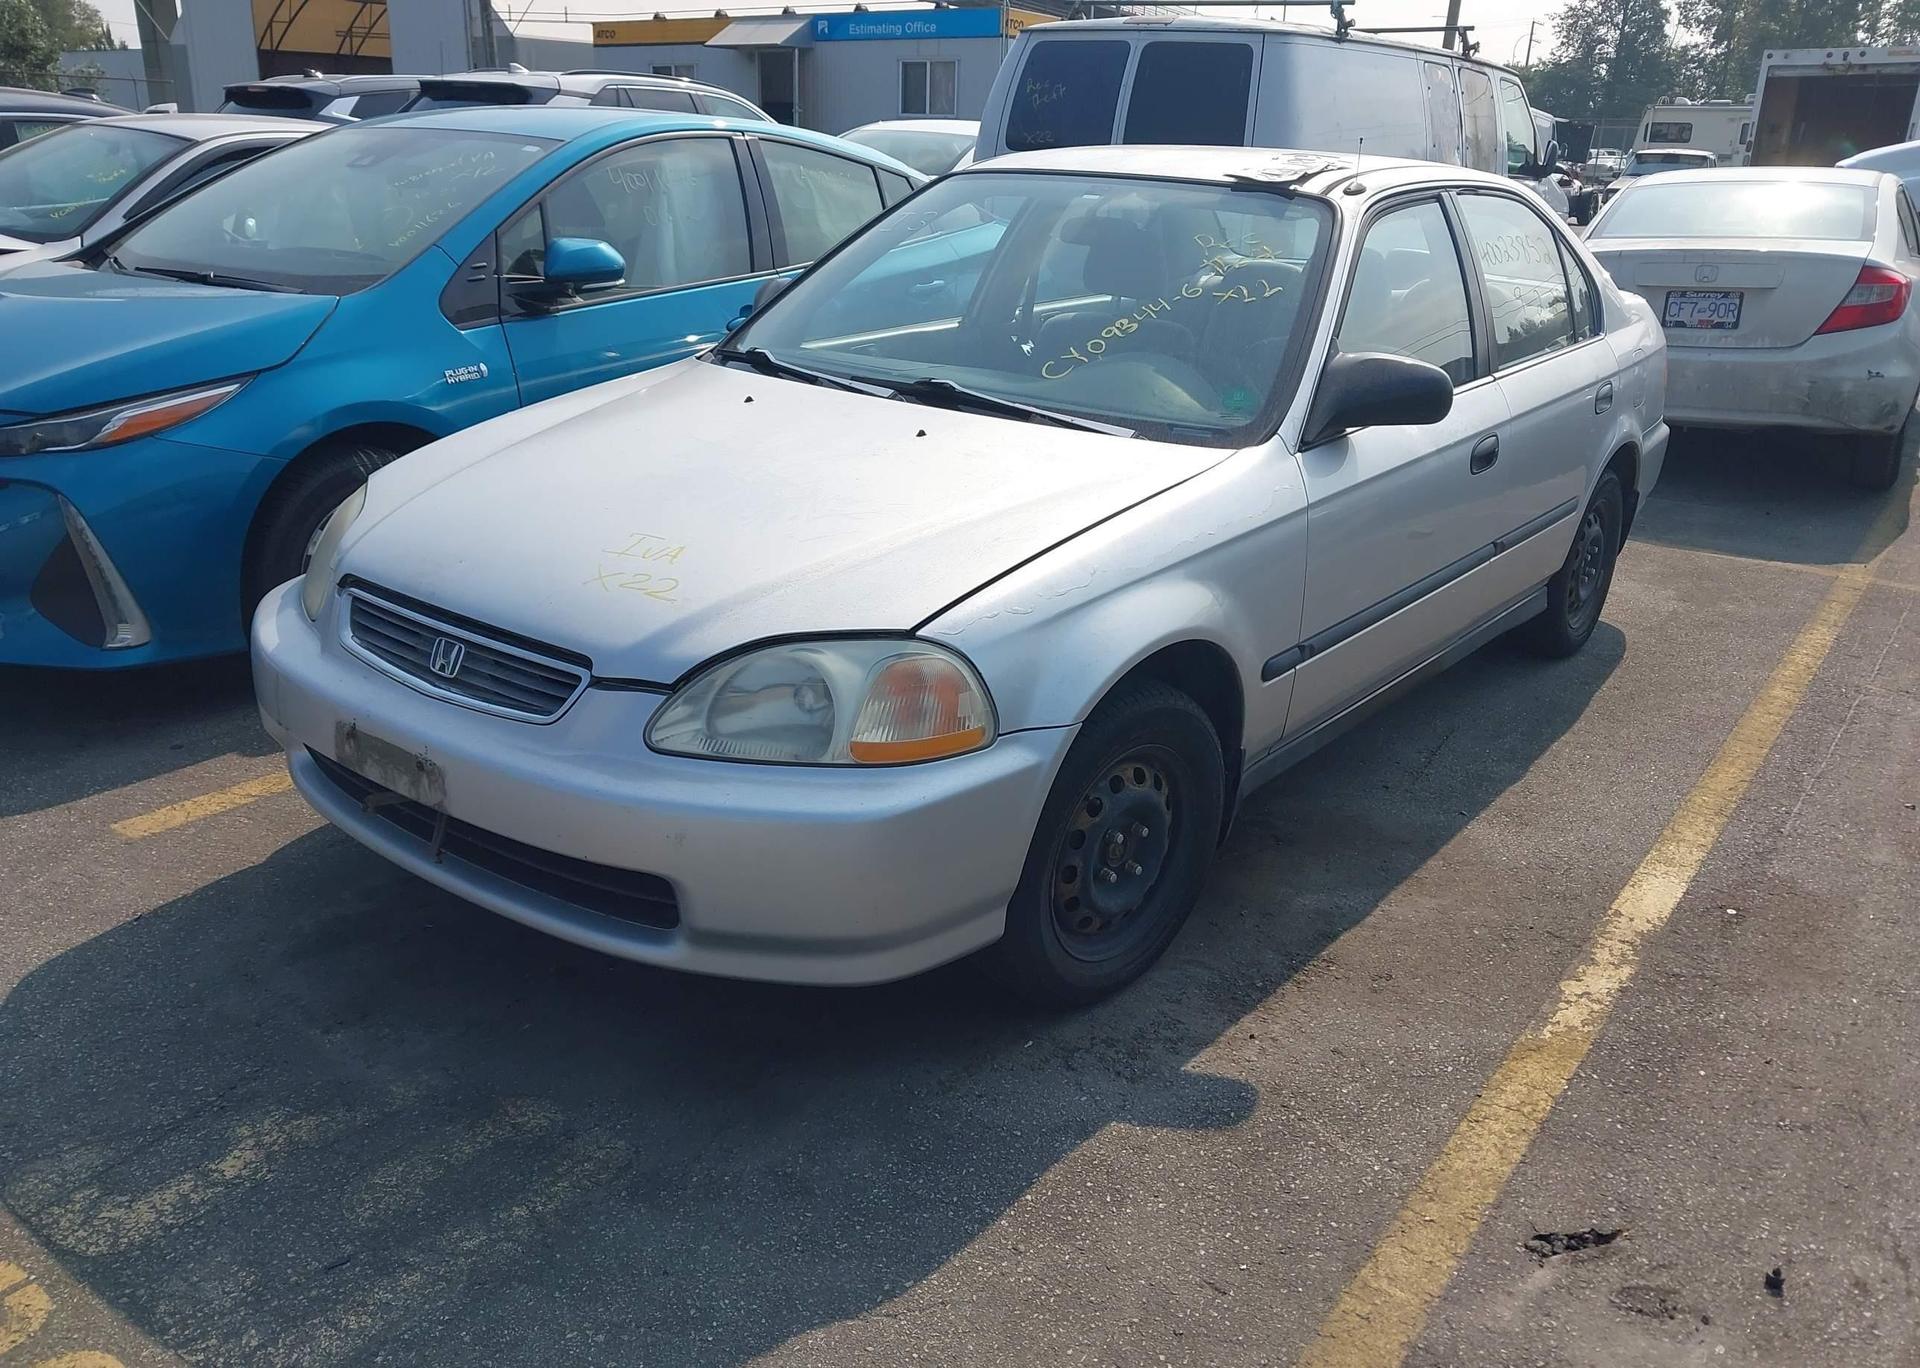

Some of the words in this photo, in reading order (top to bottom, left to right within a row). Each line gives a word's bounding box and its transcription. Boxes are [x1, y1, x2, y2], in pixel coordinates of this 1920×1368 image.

[849, 22, 903, 35] Estimating
[905, 21, 937, 33] Office
[1212, 279, 1284, 305] X22
[1685, 291, 1726, 299] Surrey
[446, 372, 481, 384] HYBRID
[582, 563, 680, 602] X22
